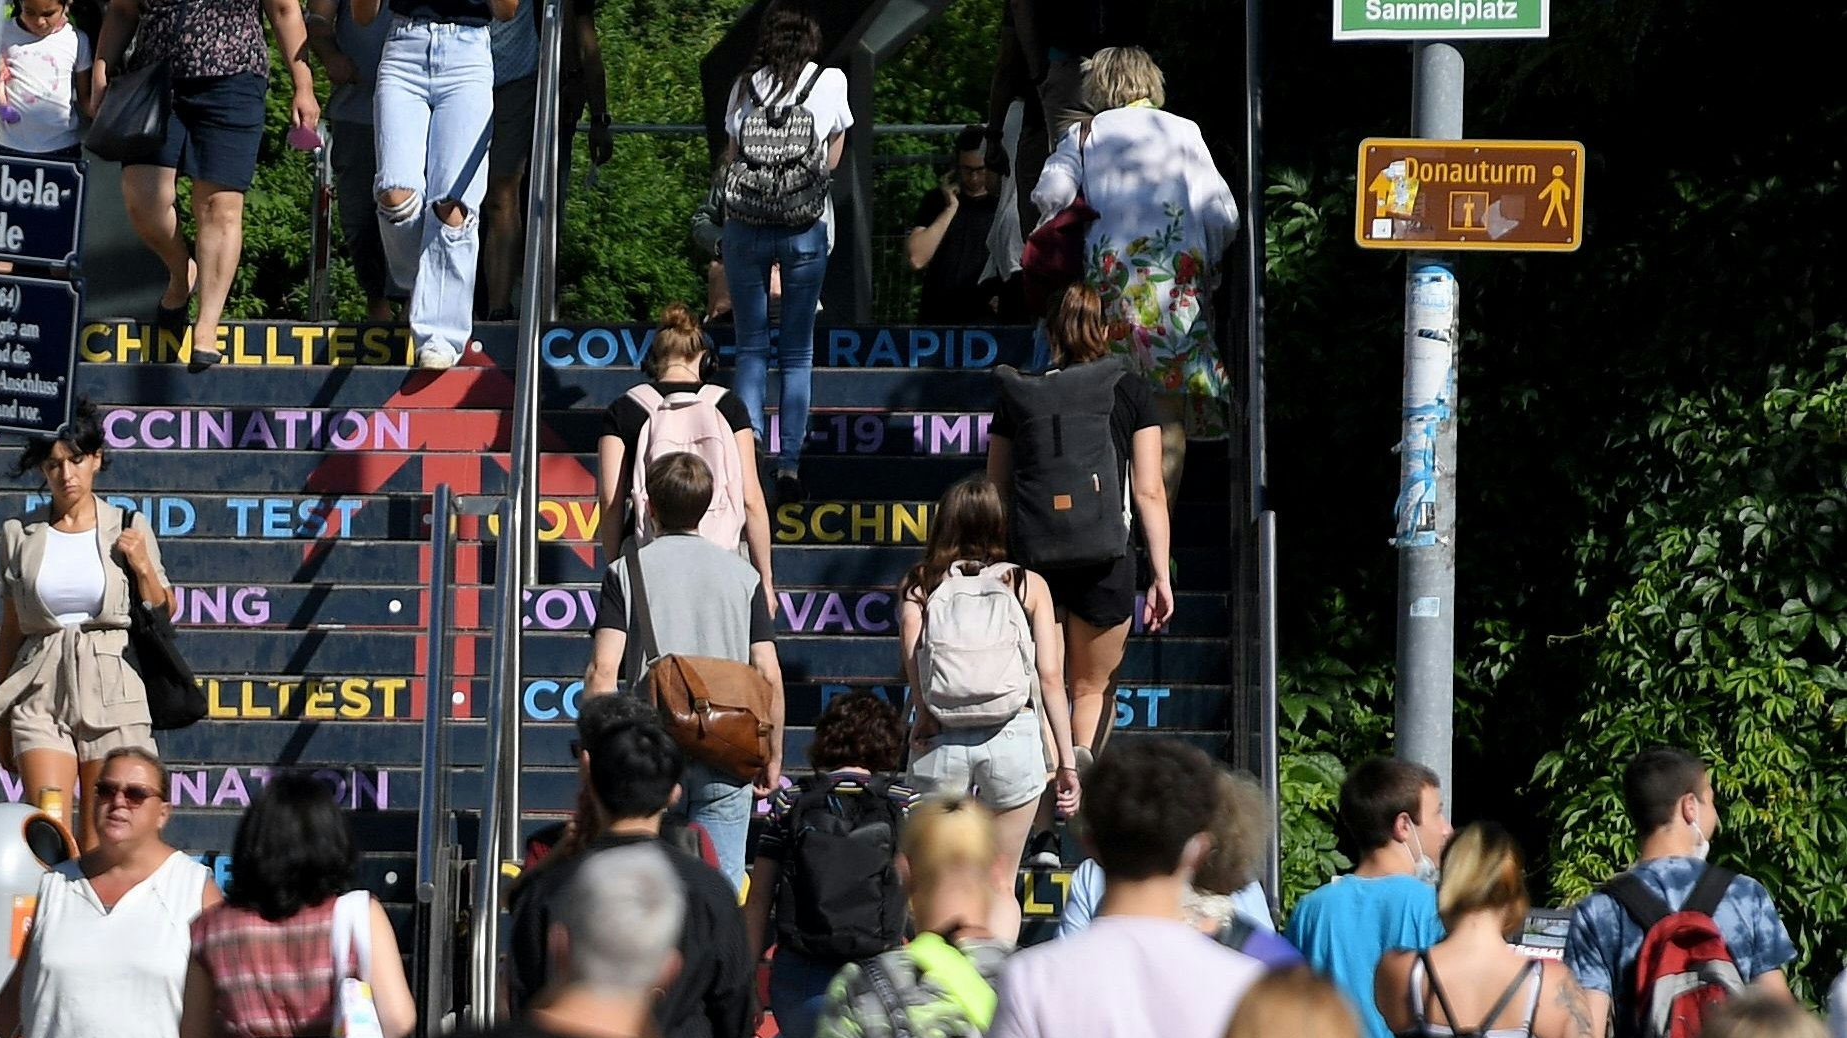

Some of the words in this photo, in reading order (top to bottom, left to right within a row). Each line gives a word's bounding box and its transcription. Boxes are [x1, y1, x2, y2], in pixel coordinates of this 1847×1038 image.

[1365, 0, 1518, 25] Sammelplatz
[1404, 156, 1537, 185] Donauturm
[19, 323, 40, 339] am
[12, 344, 32, 365] die
[829, 329, 999, 369] RAPID
[19, 405, 43, 422] vor.
[102, 409, 410, 450] CCINATION
[227, 496, 362, 539] TEST
